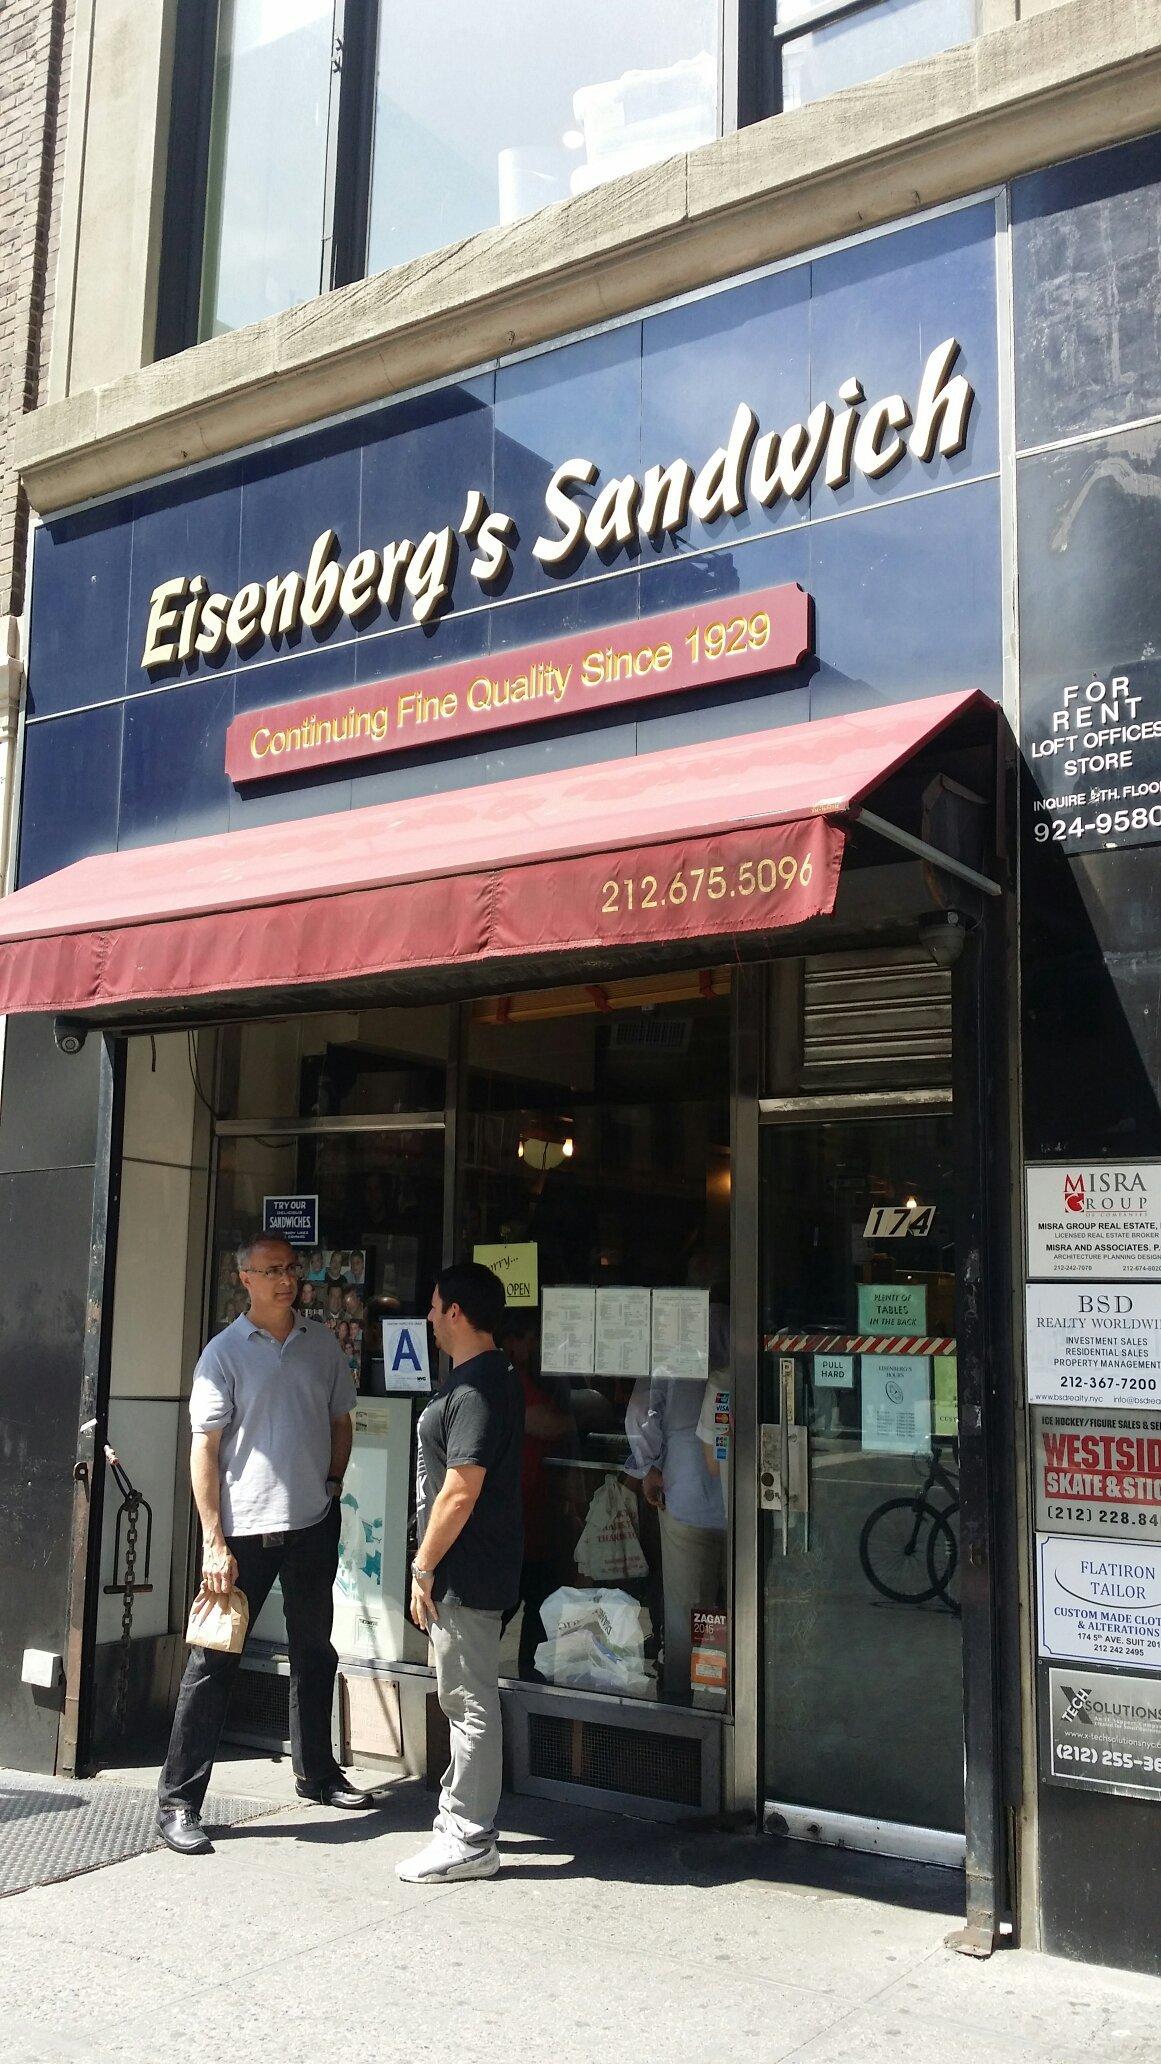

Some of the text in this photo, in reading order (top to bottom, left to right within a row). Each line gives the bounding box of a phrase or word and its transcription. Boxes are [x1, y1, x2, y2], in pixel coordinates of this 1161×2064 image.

[141, 337, 975, 671] Eisenberg's Sandwich
[250, 610, 771, 760] Continuing Fine Quality Since 1929
[1064, 676, 1130, 708] FOR
[1053, 696, 1142, 732] RENT
[1032, 721, 1161, 758] LOFT OFFICES
[1064, 750, 1133, 776] STORE
[1034, 794, 1086, 812] INQUIRE
[1123, 781, 1161, 798] FLOO
[1034, 806, 1161, 843] 924-9580
[602, 852, 814, 914] 212.675.5096
[1064, 1172, 1147, 1193] MISRA
[871, 1208, 930, 1236] 174
[507, 1283, 530, 1295] OPEN
[877, 1306, 909, 1314] TABLES
[1078, 1295, 1133, 1313] BSD
[1037, 1318, 1161, 1329] REALTY WORLDWI
[1066, 1337, 1117, 1345] INVESTMENT
[392, 1329, 422, 1371] A
[1065, 1348, 1149, 1357] RESIDENTIAL SALES
[823, 1361, 843, 1369] PULL
[1054, 1359, 1160, 1369] PROPERTY MANAGEMENT
[821, 1370, 845, 1378] HARD
[1061, 1377, 1157, 1390] 212-367-7200
[1035, 1394, 1103, 1403] www.bsdrealty.nyc
[1042, 1417, 1053, 1425] ICE
[1055, 1417, 1116, 1428] HOCKEY/FIGURE
[1118, 1420, 1141, 1429] SALES
[1143, 1421, 1148, 1429] &
[1047, 1472, 1103, 1496] SKATE
[1106, 1476, 1121, 1498] &
[1048, 1505, 1092, 1521] (212)
[1081, 1561, 1155, 1579] FLATIRON
[1091, 1582, 1146, 1599] TAILOR
[694, 1613, 726, 1624] ZAGAT
[1054, 1607, 1097, 1619] CUSTOM
[1100, 1612, 1131, 1624] MADE
[1078, 1621, 1159, 1637] & ALTERATIONS
[1105, 1636, 1123, 1644] AVE.
[1126, 1638, 1144, 1646] SUIT
[1126, 1648, 1144, 1656] 2495
[1061, 1688, 1089, 1723] TECH
[1057, 1744, 1098, 1763] (212)
